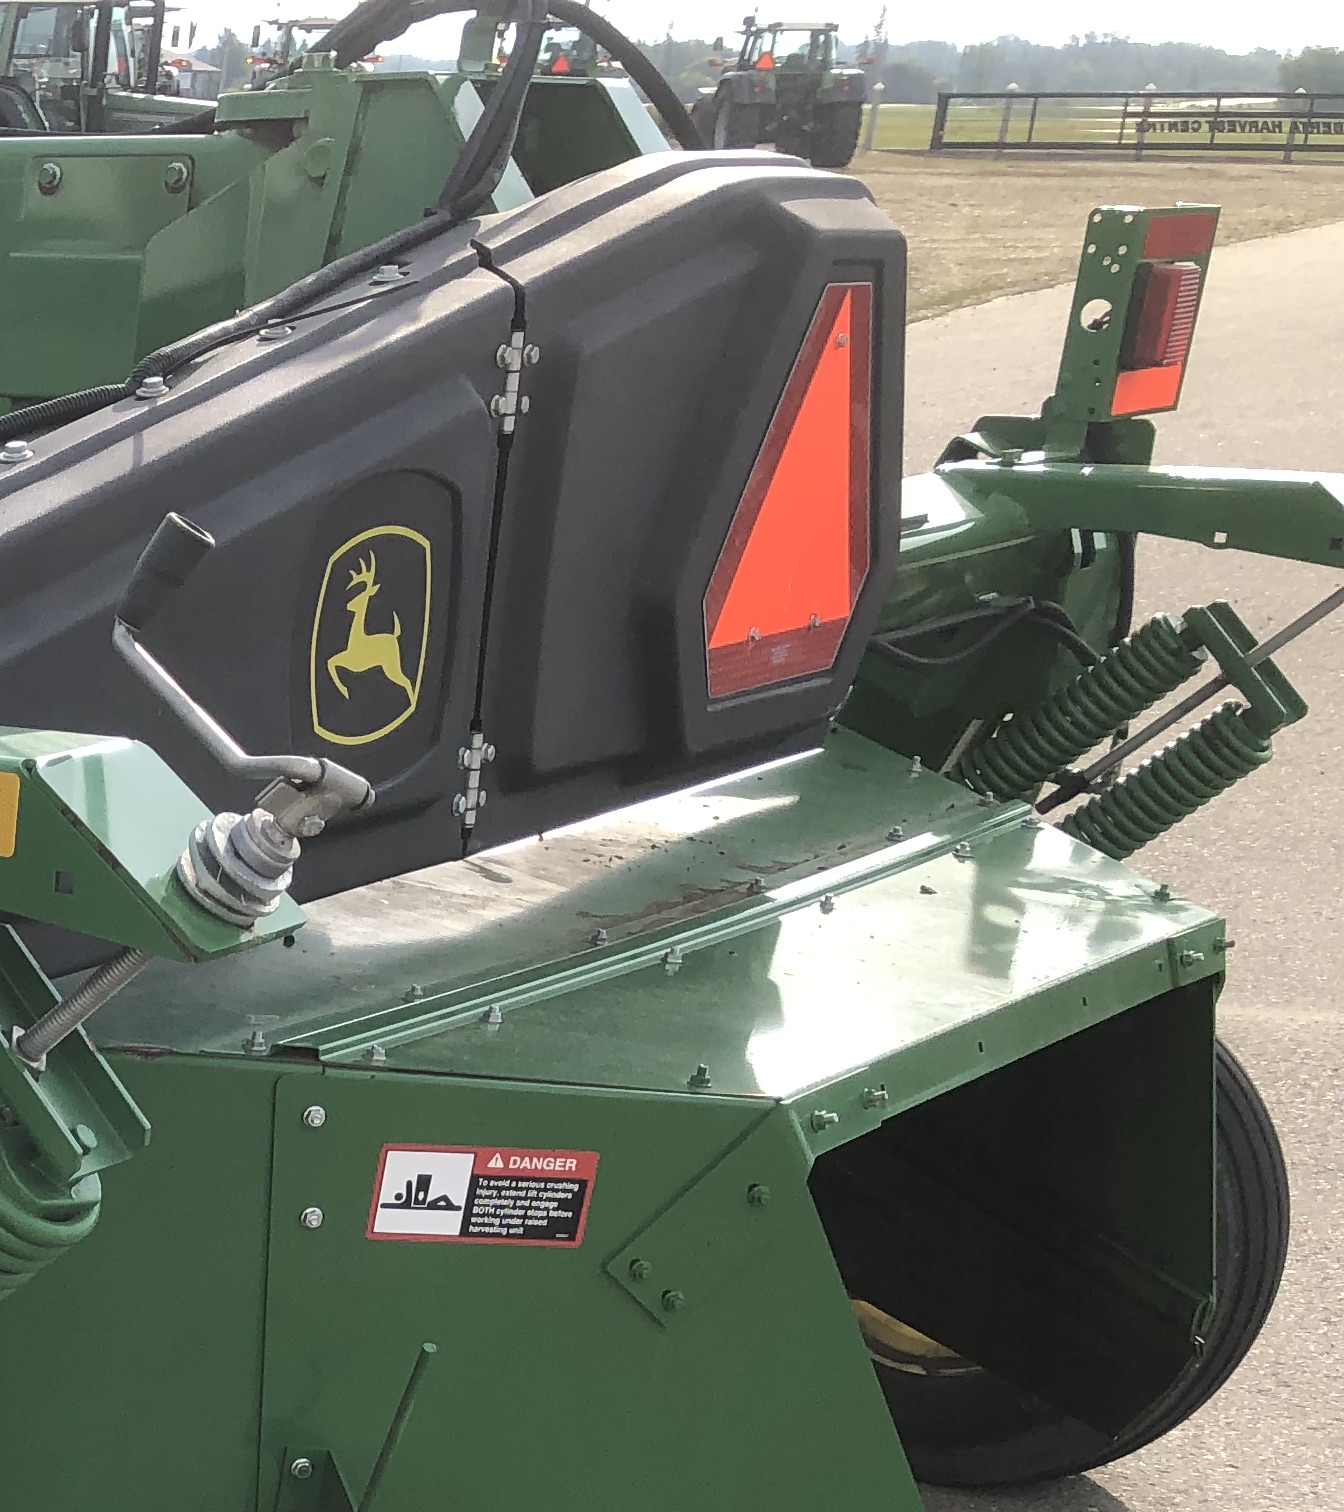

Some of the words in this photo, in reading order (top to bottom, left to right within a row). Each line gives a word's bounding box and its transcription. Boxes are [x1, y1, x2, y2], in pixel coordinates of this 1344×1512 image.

[508, 1156, 577, 1171] DANGER
[478, 1178, 488, 1186] To
[489, 1179, 510, 1187] avoid
[518, 1180, 545, 1188] serious
[546, 1181, 579, 1192] crushing
[539, 1191, 572, 1199] cylinders
[474, 1198, 514, 1207] completely
[531, 1200, 558, 1209] engage
[472, 1206, 495, 1214] BOTH
[496, 1207, 525, 1216] cylinder
[527, 1209, 547, 1217] stops
[549, 1210, 572, 1218] before
[471, 1216, 500, 1225] working
[525, 1218, 547, 1226] raised
[469, 1225, 507, 1235] harvesting
